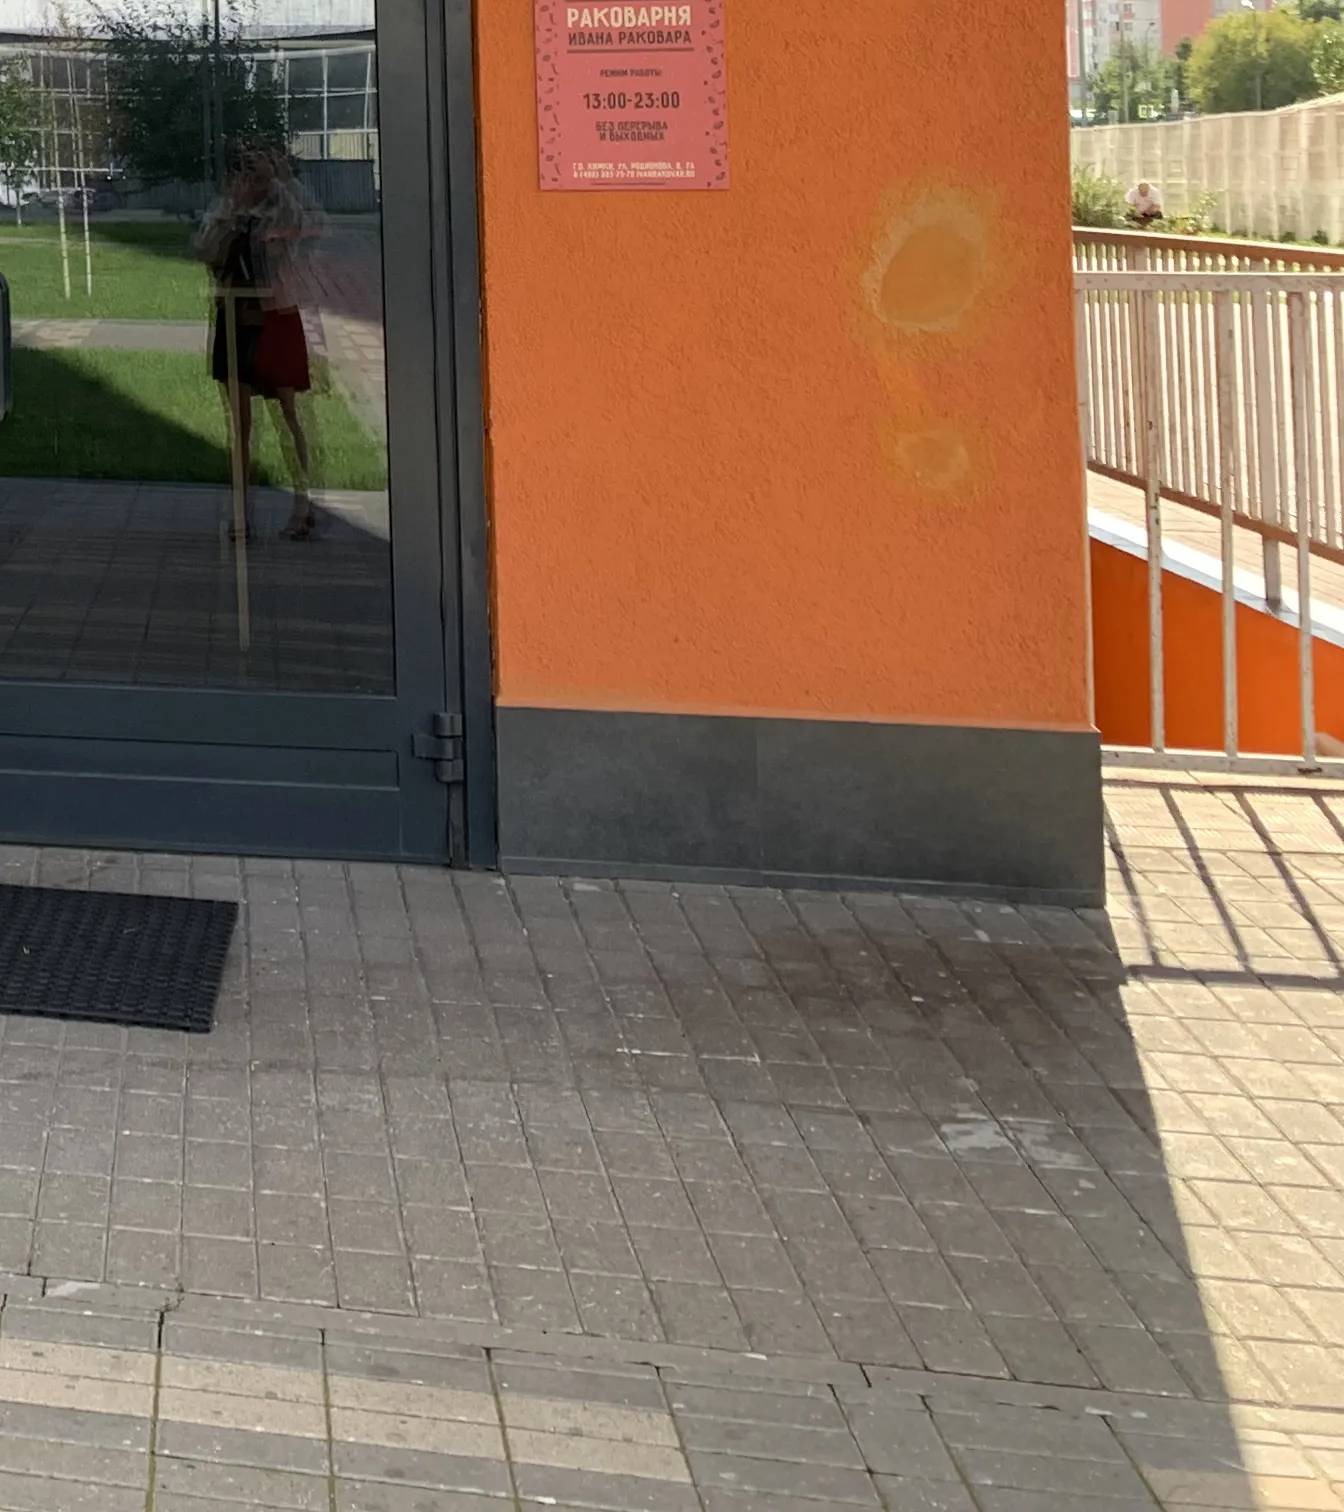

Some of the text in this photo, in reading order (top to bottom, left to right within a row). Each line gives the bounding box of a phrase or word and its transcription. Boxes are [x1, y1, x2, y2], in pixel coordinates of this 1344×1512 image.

[567, 5, 692, 28] РАКОВАРНЯ
[568, 30, 692, 46] ИВАНА РАКОВАРА
[583, 91, 680, 110] 13:00-23:00
[596, 120, 668, 131] БЕЗ ПЕРЕРЫВА
[599, 131, 664, 141] И ВЫХОДНЫХ
